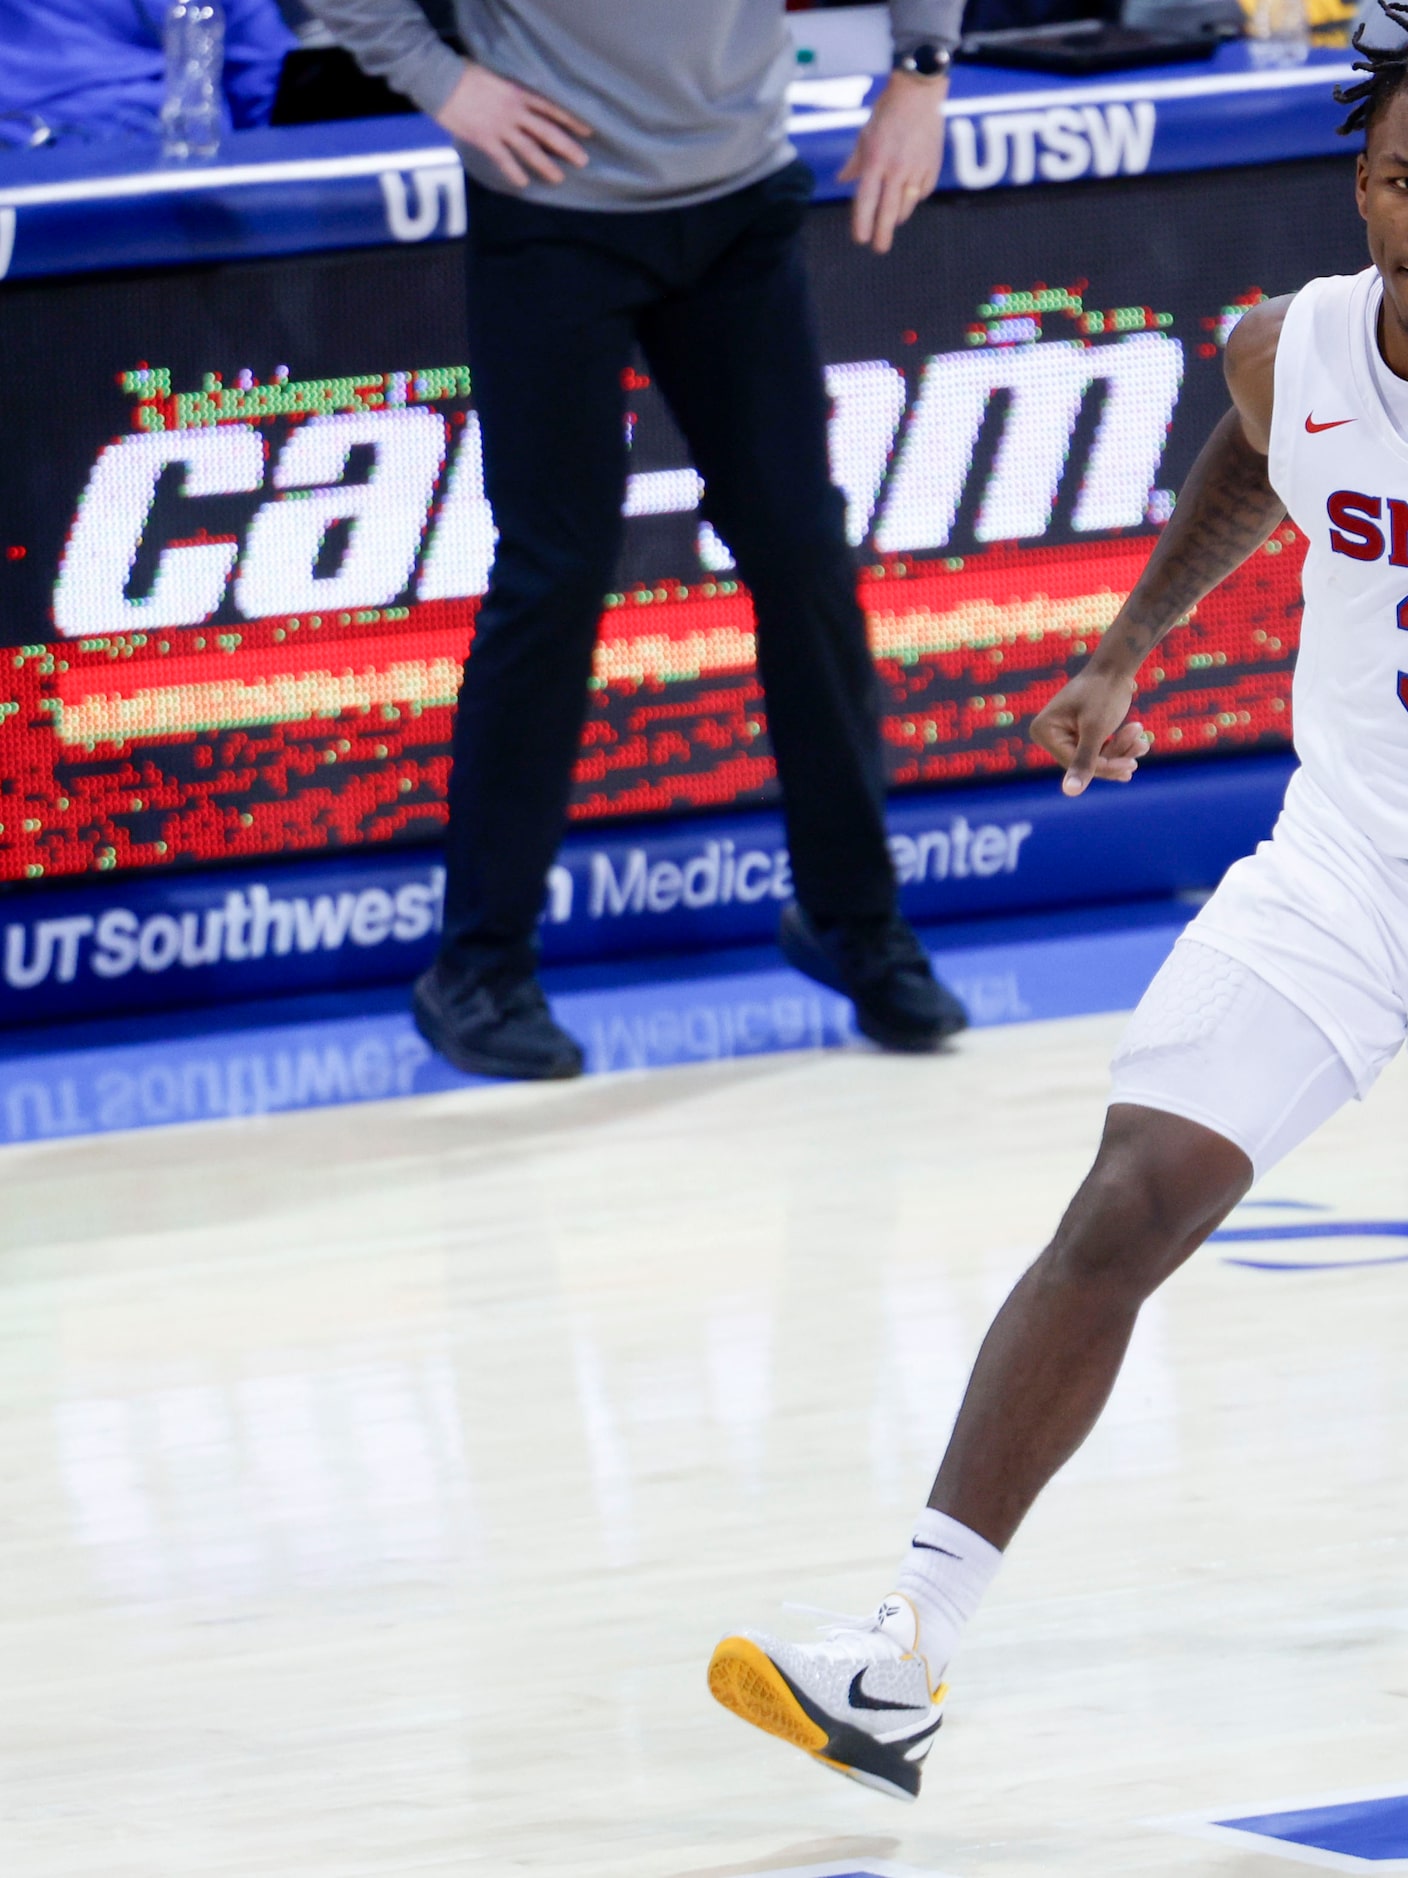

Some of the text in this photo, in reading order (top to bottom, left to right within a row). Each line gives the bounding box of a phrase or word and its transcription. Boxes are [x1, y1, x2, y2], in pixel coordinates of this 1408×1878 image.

[950, 100, 1156, 190] UTSW
[590, 838, 796, 916] Medica
[887, 815, 1033, 885] enter
